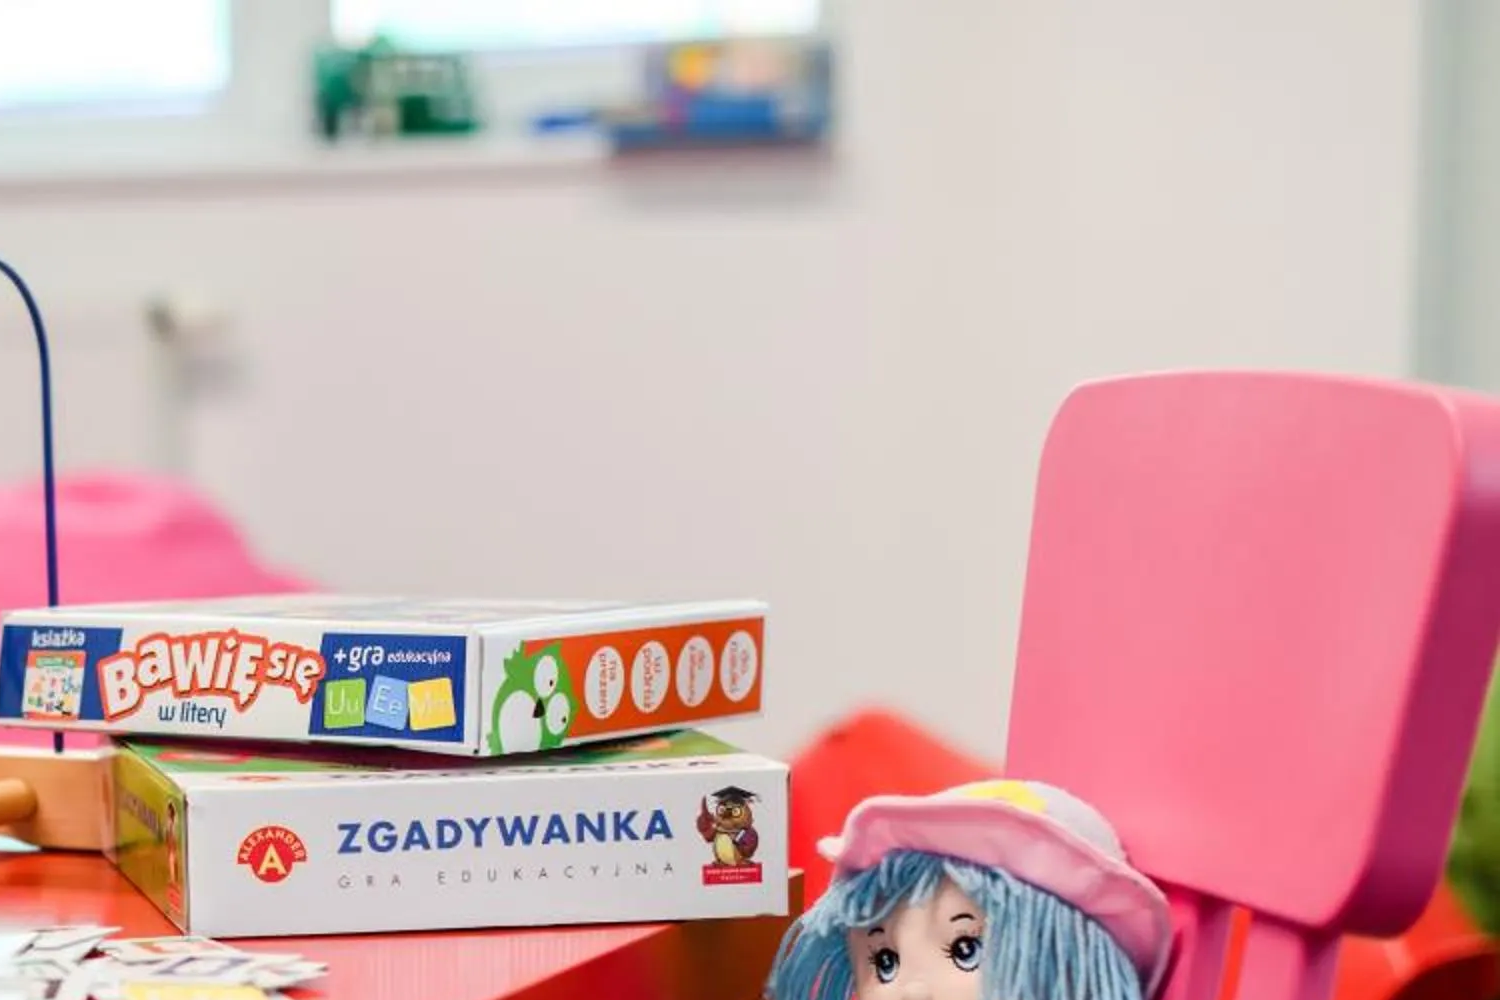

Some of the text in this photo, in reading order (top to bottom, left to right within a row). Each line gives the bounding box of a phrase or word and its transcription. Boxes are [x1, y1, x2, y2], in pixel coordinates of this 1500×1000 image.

[387, 649, 452, 665] edukacyjna
[158, 701, 227, 729] w litery
[239, 827, 305, 861] ALEXANDER
[336, 808, 674, 855] ZGADYWANKA
[258, 842, 288, 875] A
[338, 861, 675, 889] GRA EDUKACYJNA
